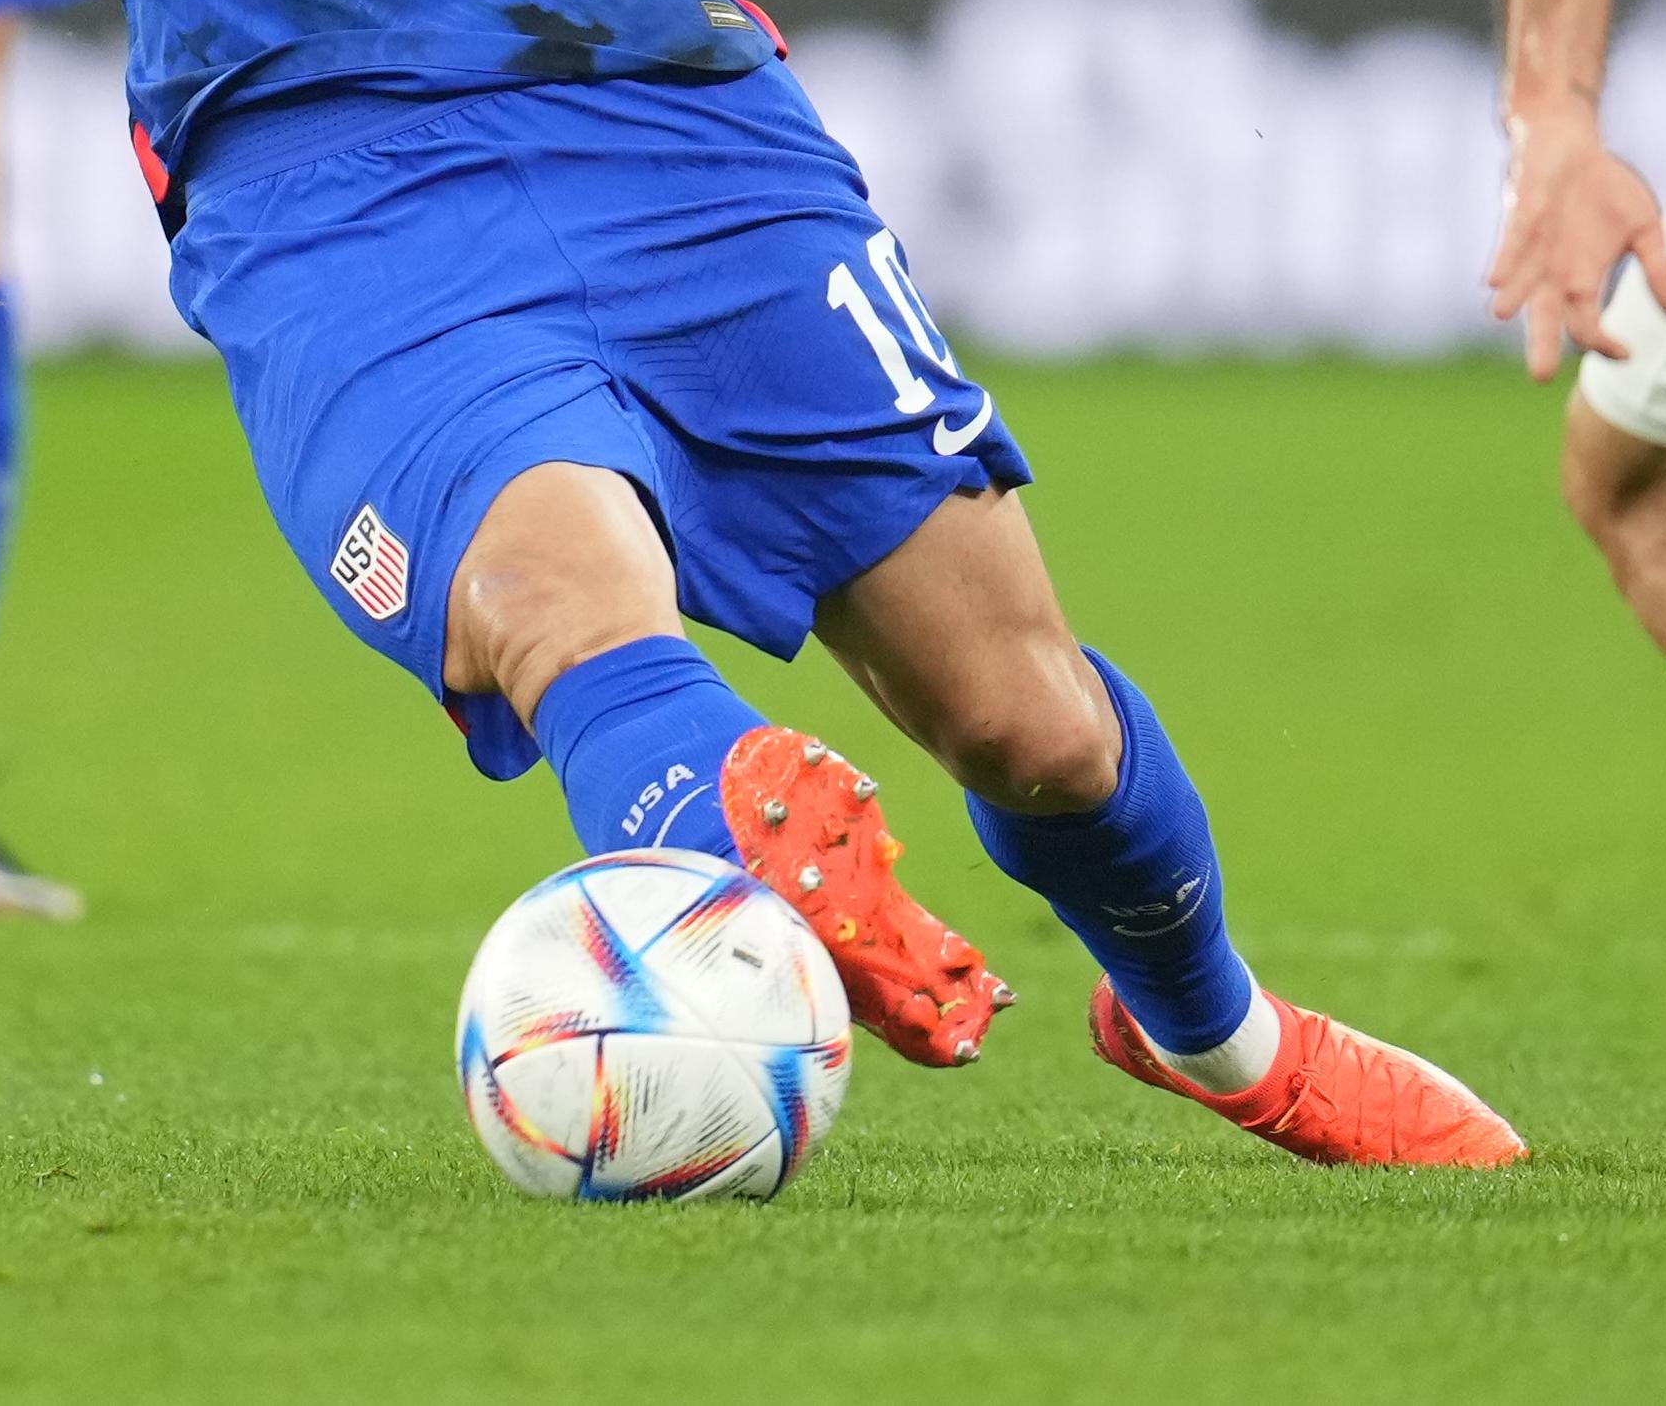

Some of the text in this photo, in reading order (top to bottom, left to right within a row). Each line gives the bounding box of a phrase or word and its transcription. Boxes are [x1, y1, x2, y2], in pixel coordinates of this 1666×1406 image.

[826, 226, 959, 414] 10
[335, 513, 376, 584] USA
[621, 763, 696, 837] USA
